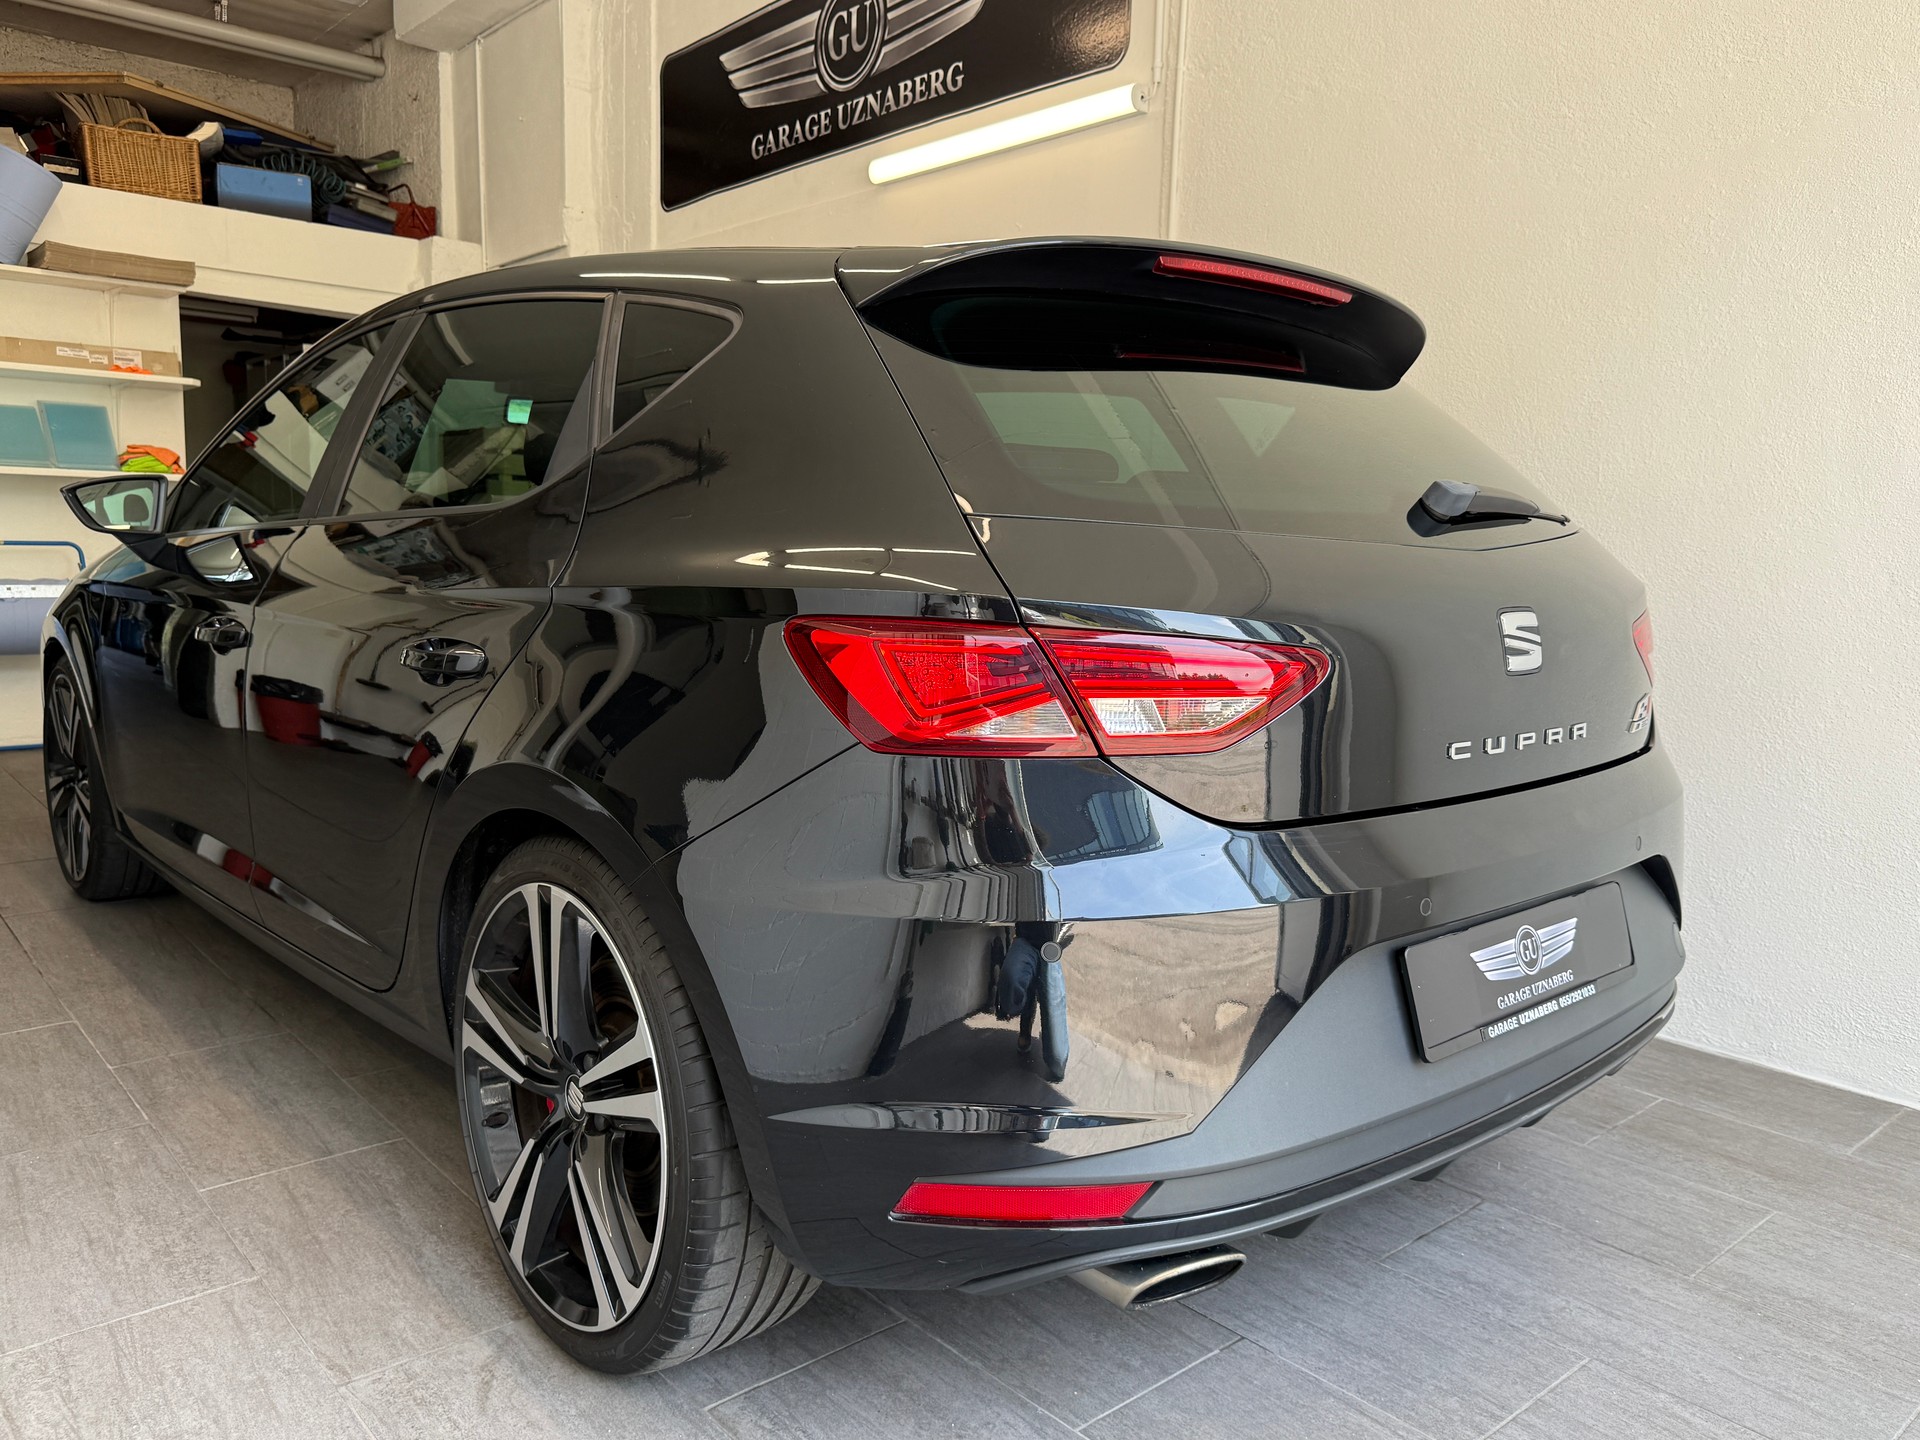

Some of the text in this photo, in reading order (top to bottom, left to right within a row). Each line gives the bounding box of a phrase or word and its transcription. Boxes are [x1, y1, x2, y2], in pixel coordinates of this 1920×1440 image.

[828, 0, 873, 61] GU
[751, 61, 965, 160] GARAGE UZNABERG
[1446, 722, 1587, 760] CUPRA
[1520, 937, 1537, 962] GU
[1497, 969, 1574, 1010] GARAGE UZNABERG
[1488, 1017, 1519, 1038] GARAGE
[1518, 1000, 1559, 1025] UZNABERG
